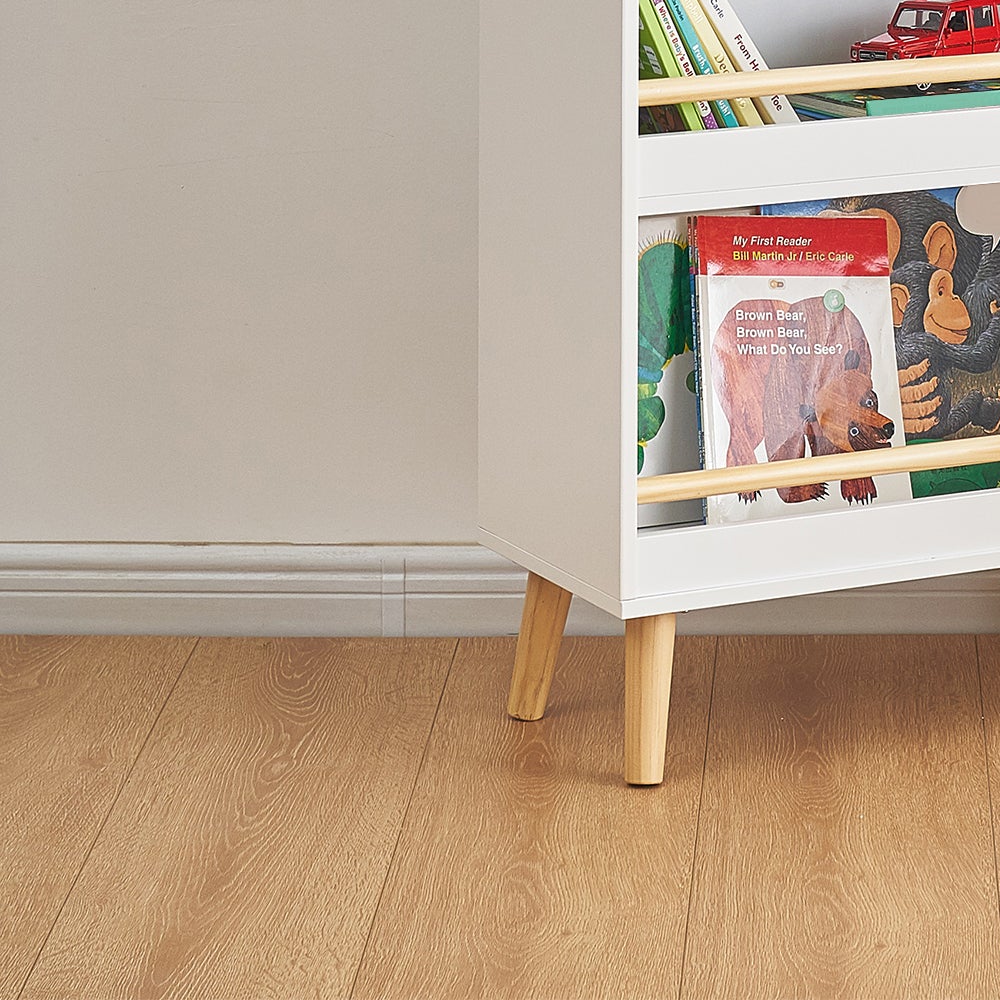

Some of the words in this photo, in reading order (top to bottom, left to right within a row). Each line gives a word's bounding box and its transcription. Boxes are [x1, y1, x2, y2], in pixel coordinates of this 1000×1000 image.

[658, 6, 672, 30] Where
[672, 37, 685, 62] Baby's
[682, 61, 694, 77] Bell
[734, 33, 751, 60] From
[771, 94, 783, 112] Toe
[732, 235, 748, 248] My
[750, 236, 774, 247] First
[776, 236, 812, 247] Reader
[732, 251, 750, 261] Bill
[752, 251, 784, 261] Martin
[787, 251, 797, 261] Jr
[805, 251, 825, 261] Eric
[828, 252, 855, 262] Carle
[735, 310, 773, 321] Brown
[776, 310, 807, 323] Bear,
[736, 326, 774, 338] Brown
[777, 327, 808, 339] Bear,
[737, 343, 768, 355] What
[771, 344, 787, 355] Do
[788, 344, 811, 355] You
[813, 344, 843, 355] See?
